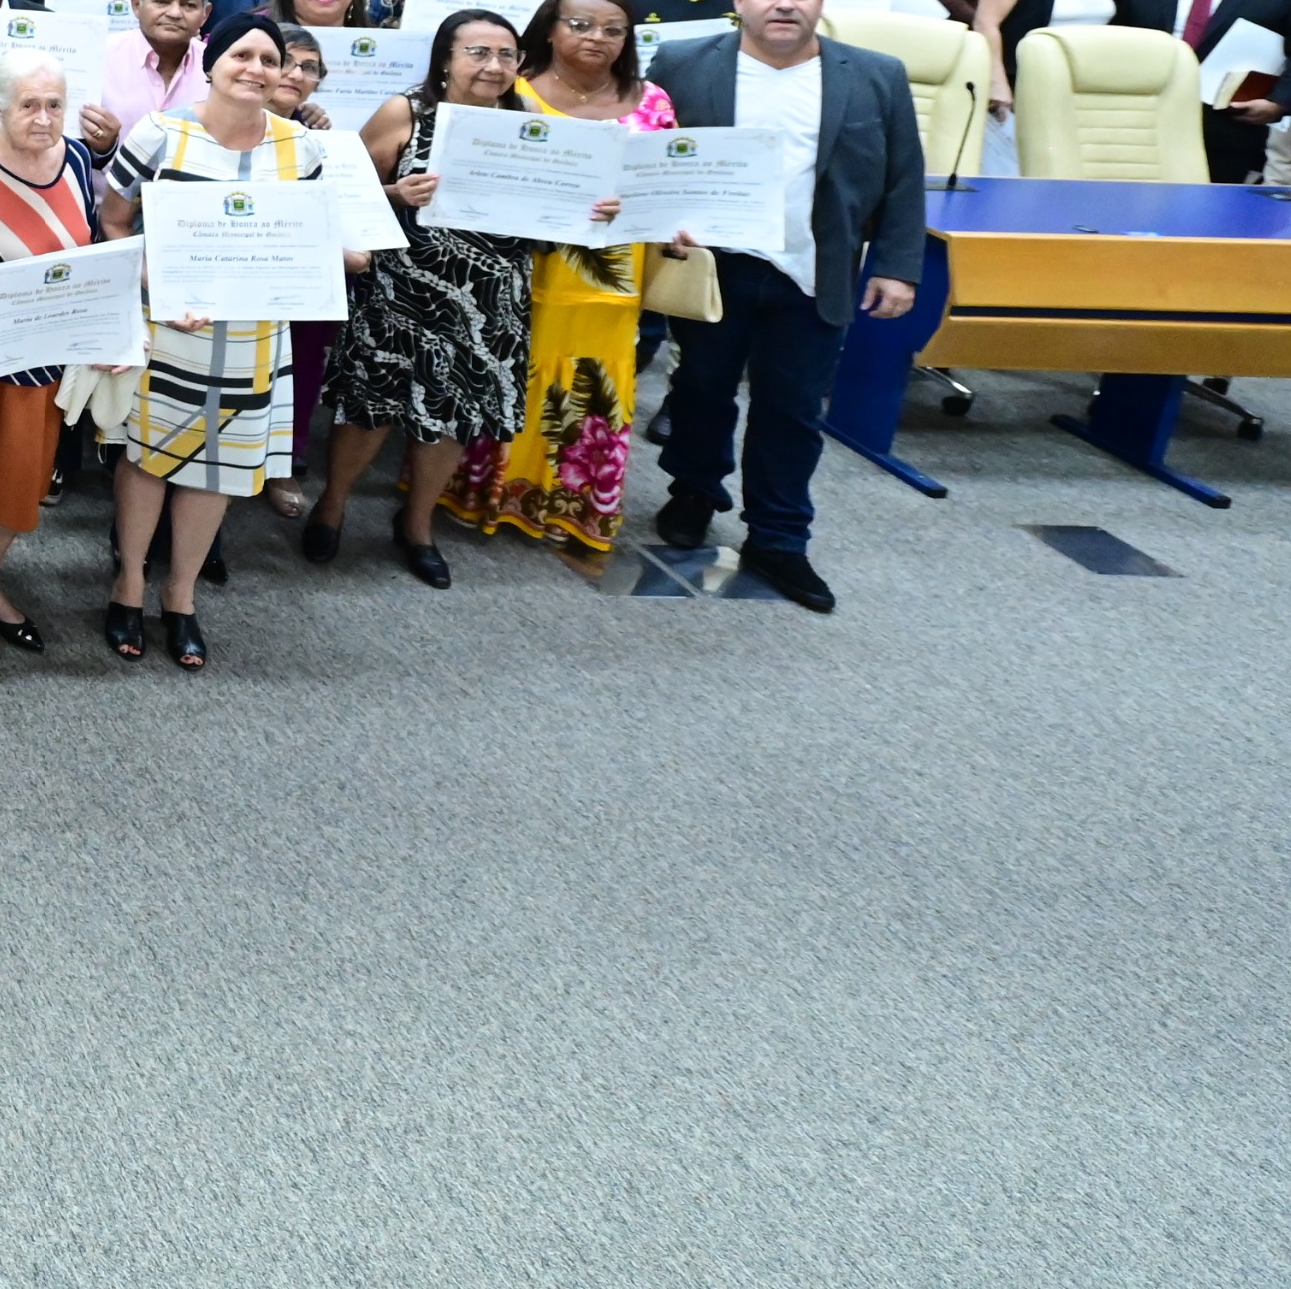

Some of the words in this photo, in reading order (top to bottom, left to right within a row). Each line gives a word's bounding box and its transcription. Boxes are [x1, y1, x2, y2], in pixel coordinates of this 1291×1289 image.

[177, 219, 215, 228] Diploma
[230, 219, 258, 228] Honra
[273, 218, 304, 228] Mérito
[189, 254, 212, 262] Maria
[214, 254, 249, 262] Catarina
